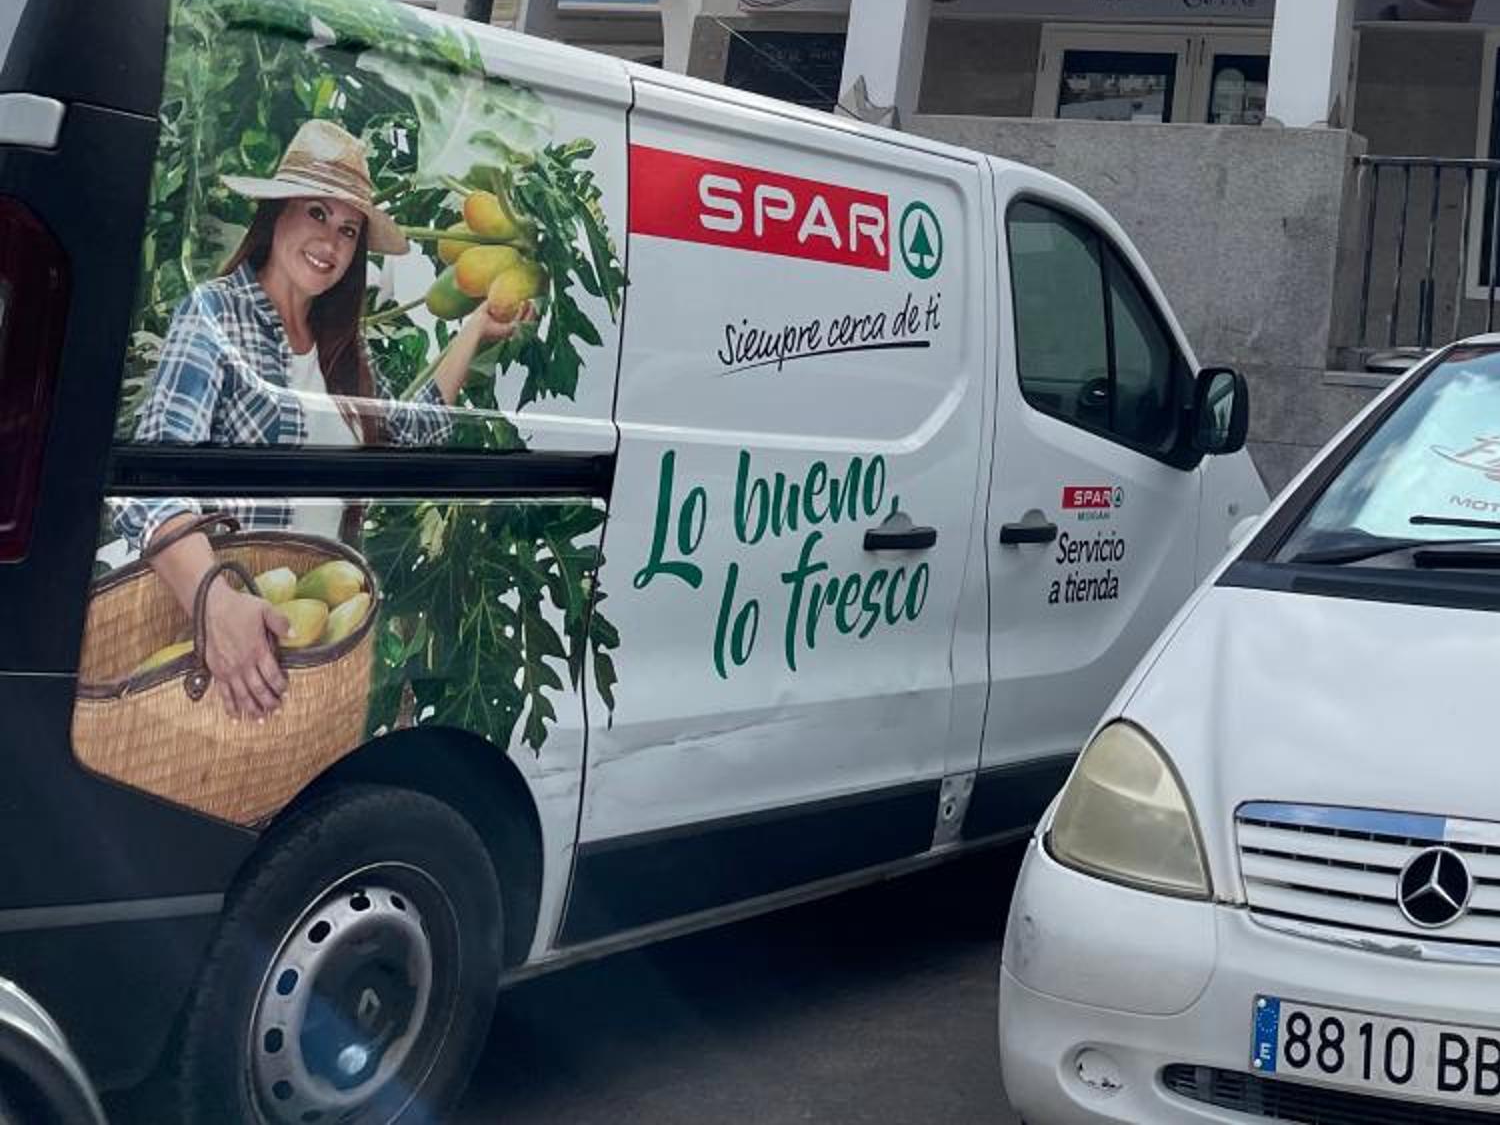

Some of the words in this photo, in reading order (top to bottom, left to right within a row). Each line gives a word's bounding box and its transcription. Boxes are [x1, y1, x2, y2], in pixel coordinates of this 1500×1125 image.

[699, 173, 886, 257] SPAR
[718, 318, 821, 372] Siempre
[827, 312, 887, 348] cerca
[893, 292, 920, 336] de
[925, 293, 941, 331] ti
[633, 449, 707, 589] Lo
[734, 449, 899, 545] bueno,
[1073, 491, 1111, 506] SPAR
[1056, 530, 1125, 564] Servicio
[713, 562, 759, 679] lo
[781, 530, 929, 672] fresco
[1048, 580, 1061, 604] a
[1065, 569, 1119, 603] tienda
[1260, 1042, 1271, 1061] E
[1284, 1011, 1415, 1085] 8810
